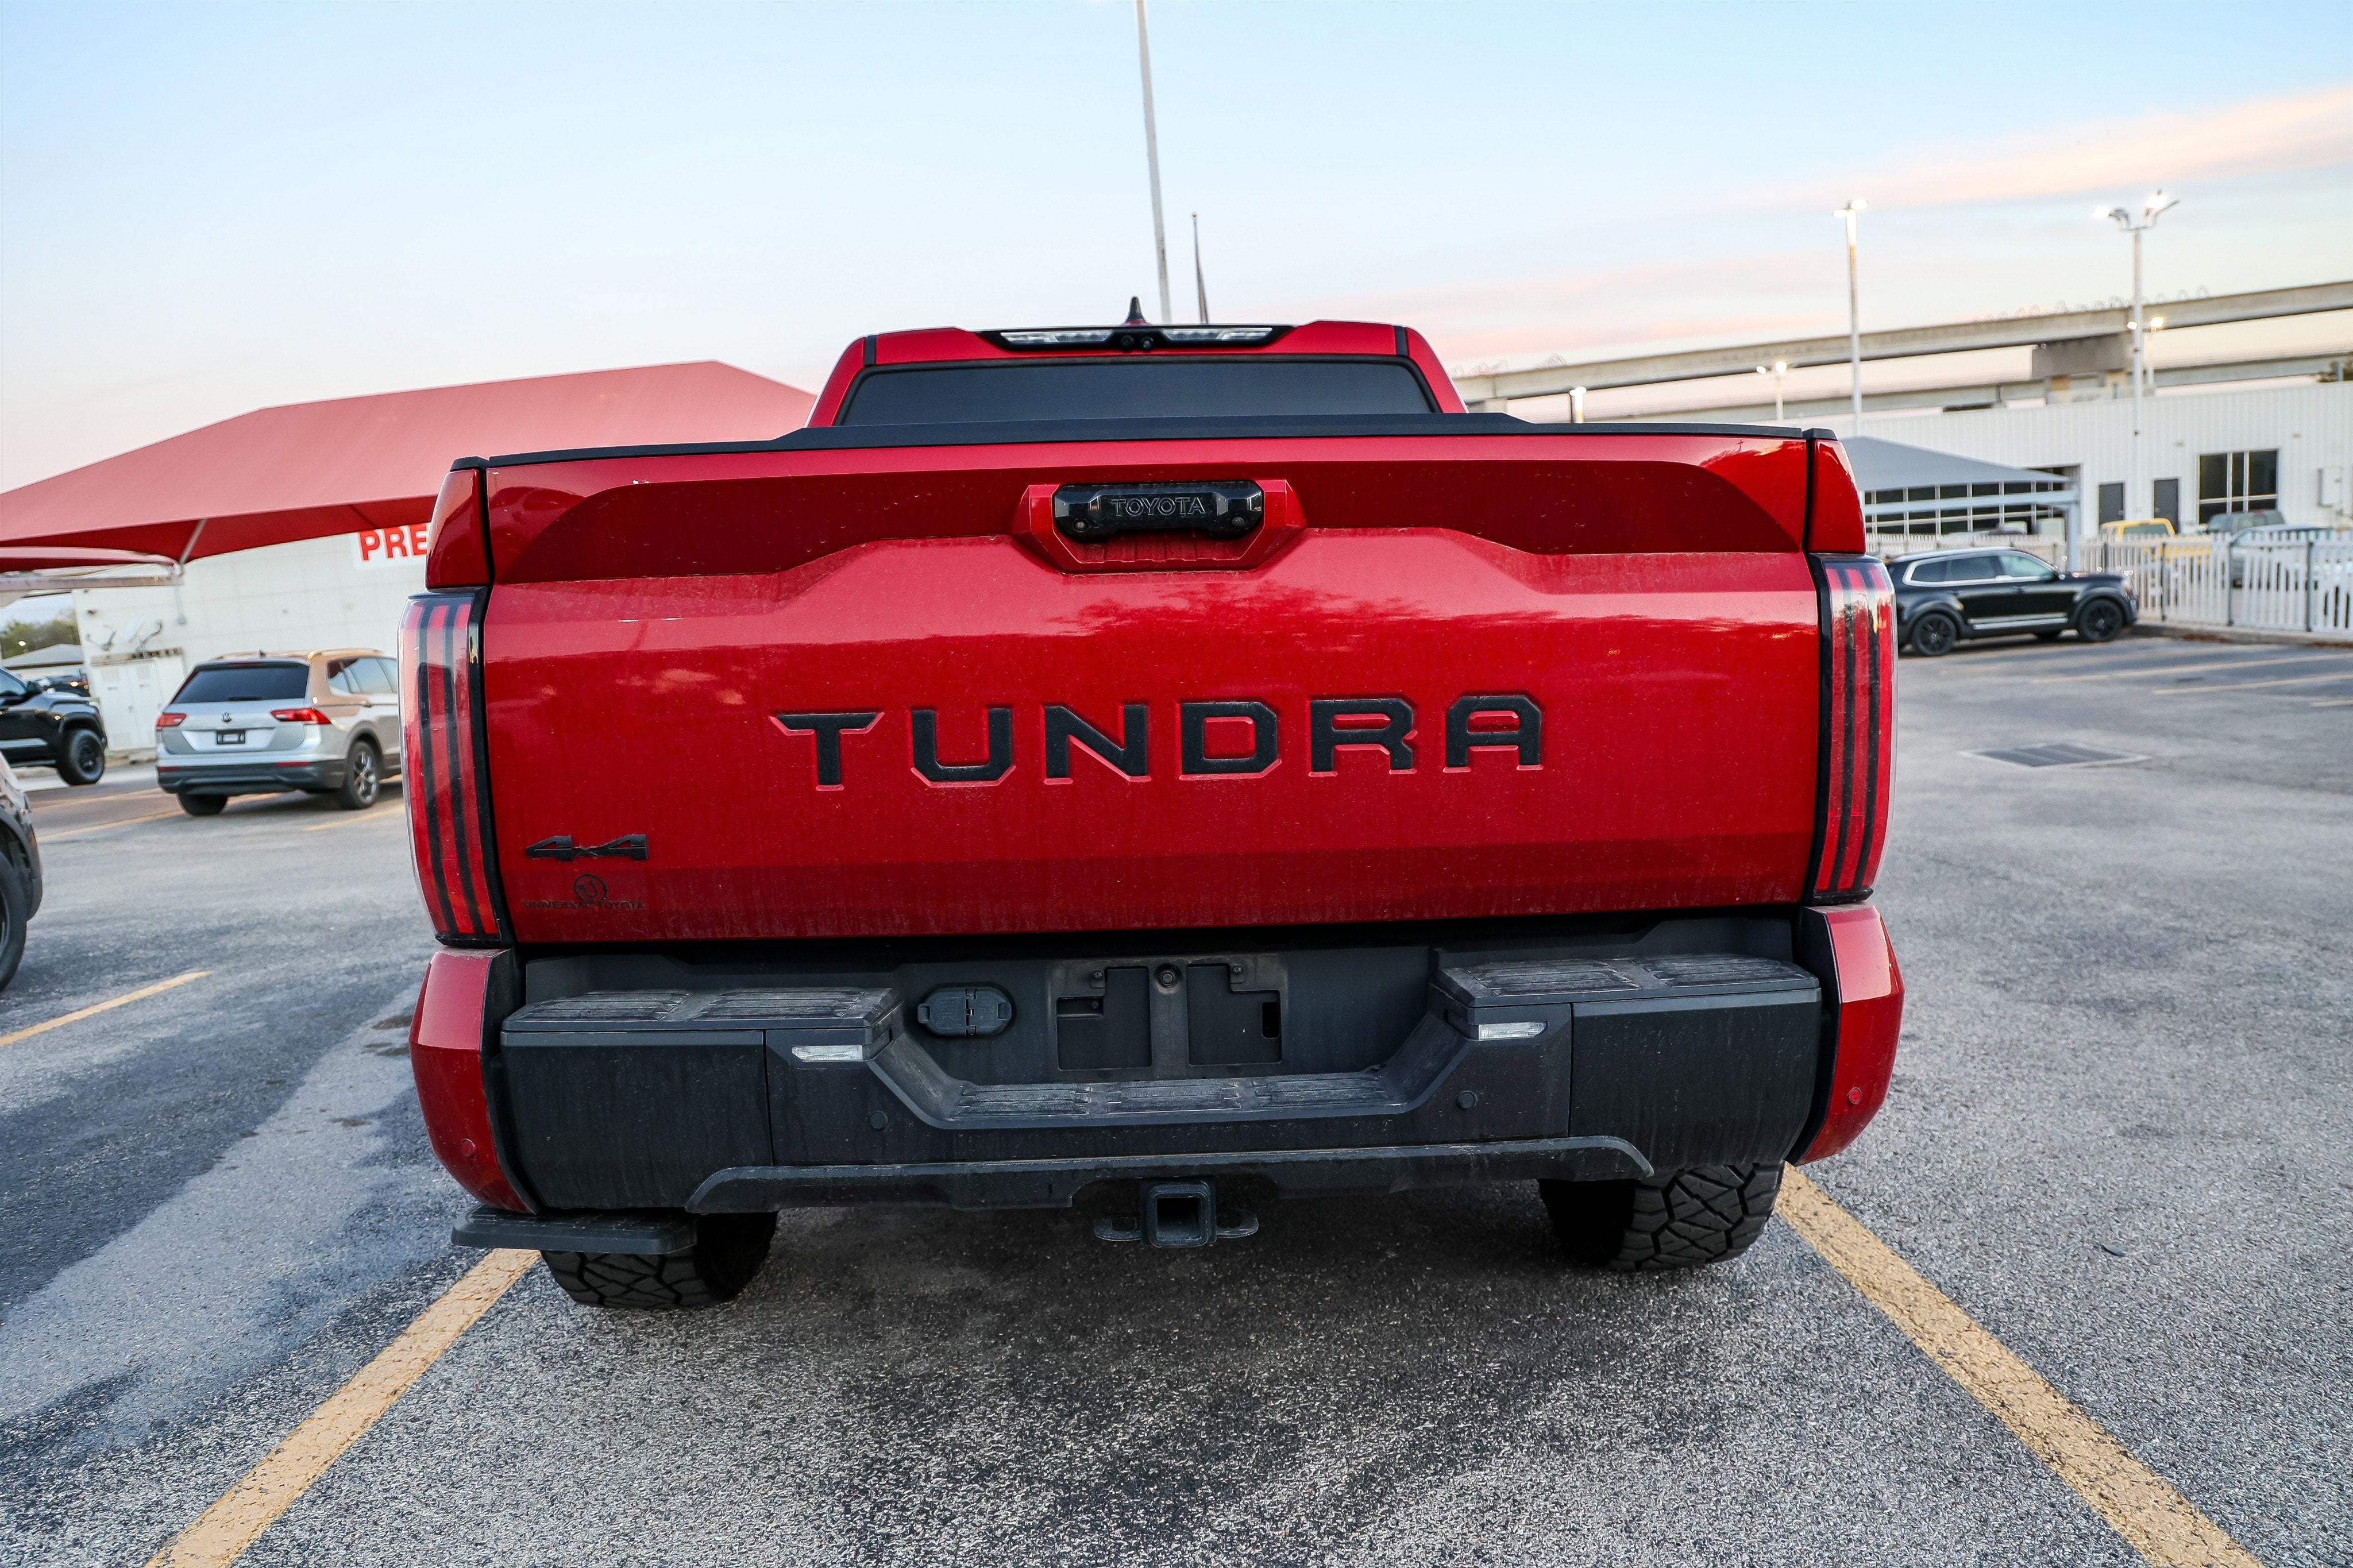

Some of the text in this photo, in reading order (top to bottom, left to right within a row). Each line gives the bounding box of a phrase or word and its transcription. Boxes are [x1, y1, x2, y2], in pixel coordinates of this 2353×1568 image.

[1111, 497, 1206, 516] TOYOTA
[770, 695, 1544, 790] TUNDRA
[523, 900, 644, 909] UNIVERSAL TOYOTA
